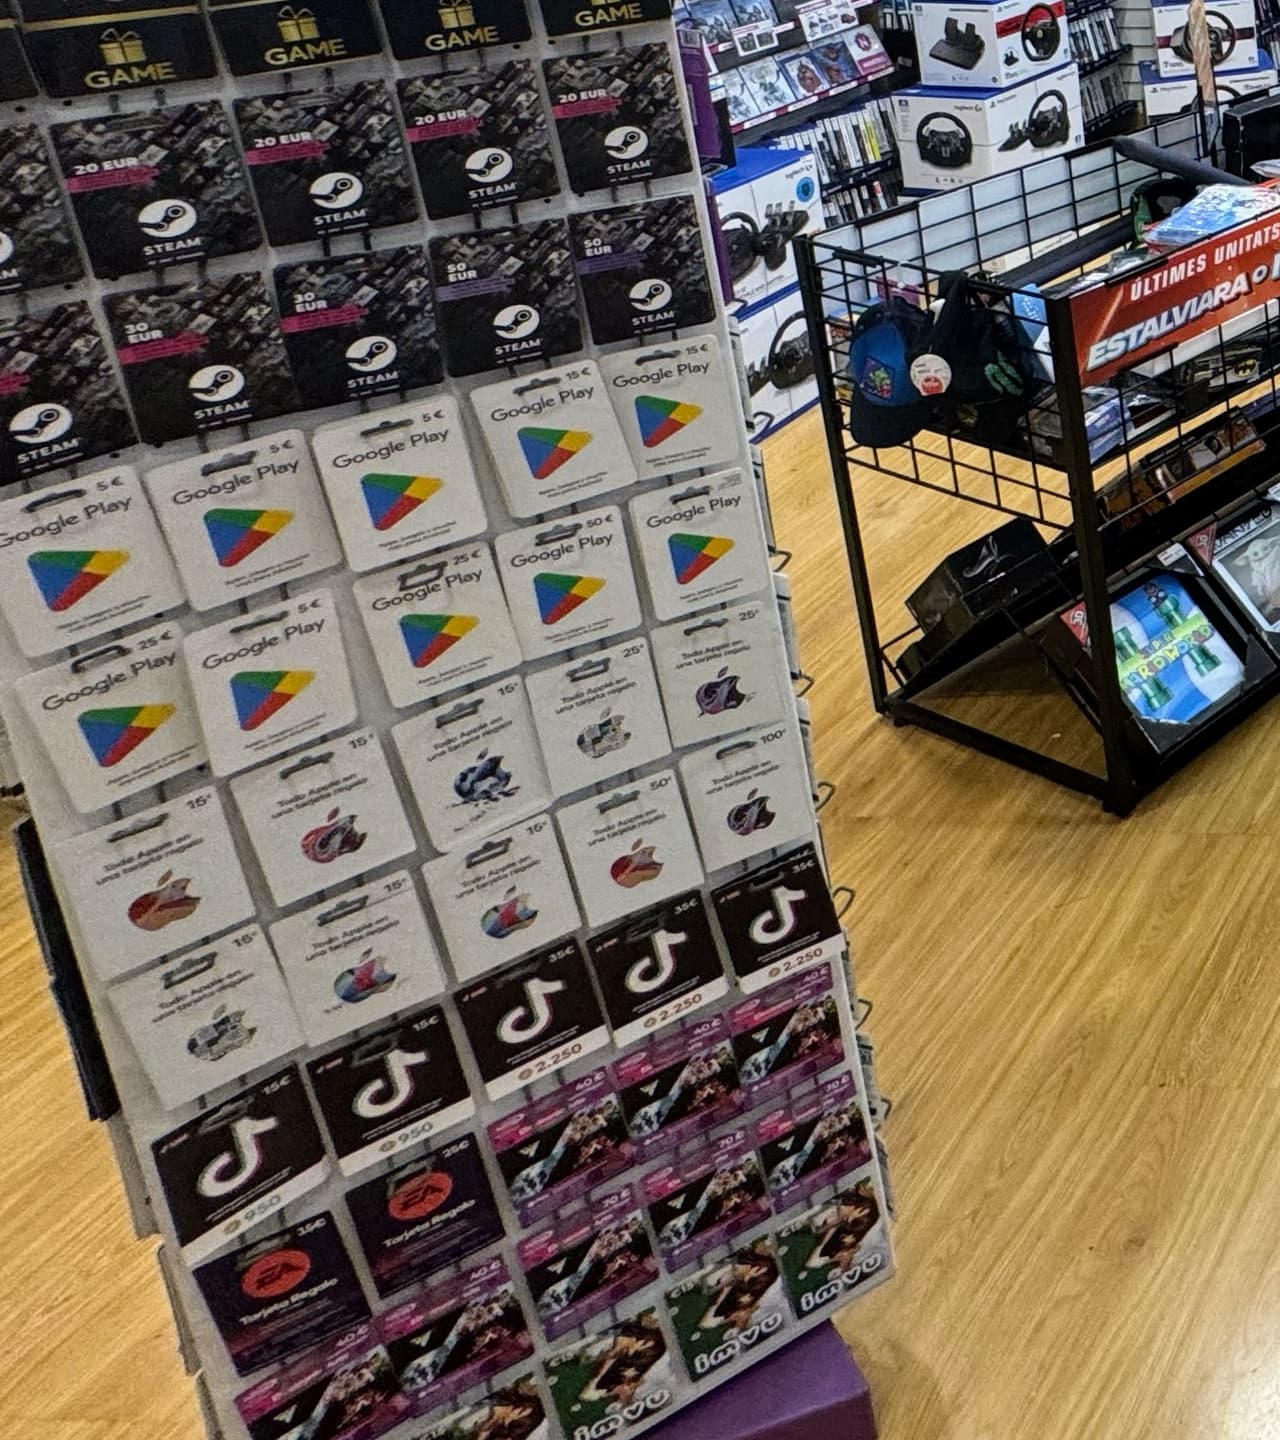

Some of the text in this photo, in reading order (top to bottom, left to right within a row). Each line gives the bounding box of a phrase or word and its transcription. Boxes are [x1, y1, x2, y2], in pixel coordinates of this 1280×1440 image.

[574, 1, 643, 27] GAME
[424, 24, 501, 51] GAME
[264, 36, 345, 66] GAME
[83, 60, 177, 89] GAME
[558, 88, 607, 105] 20 EUR
[414, 109, 468, 127] 20 EUR
[255, 130, 312, 149] 20 EUR
[605, 160, 652, 176] STEAM
[467, 182, 518, 200] STEAM
[313, 209, 365, 227] STEAM
[1131, 222, 1280, 301] ÚLTIMES UNITATS
[1087, 272, 1251, 371] ESTALVIARA
[612, 360, 711, 389] Google Play
[490, 384, 595, 423] Google Play
[333, 427, 450, 470] Google Play
[782, 948, 823, 973] 2.250
[659, 993, 703, 1023] 2.250
[398, 1121, 434, 1144] 950
